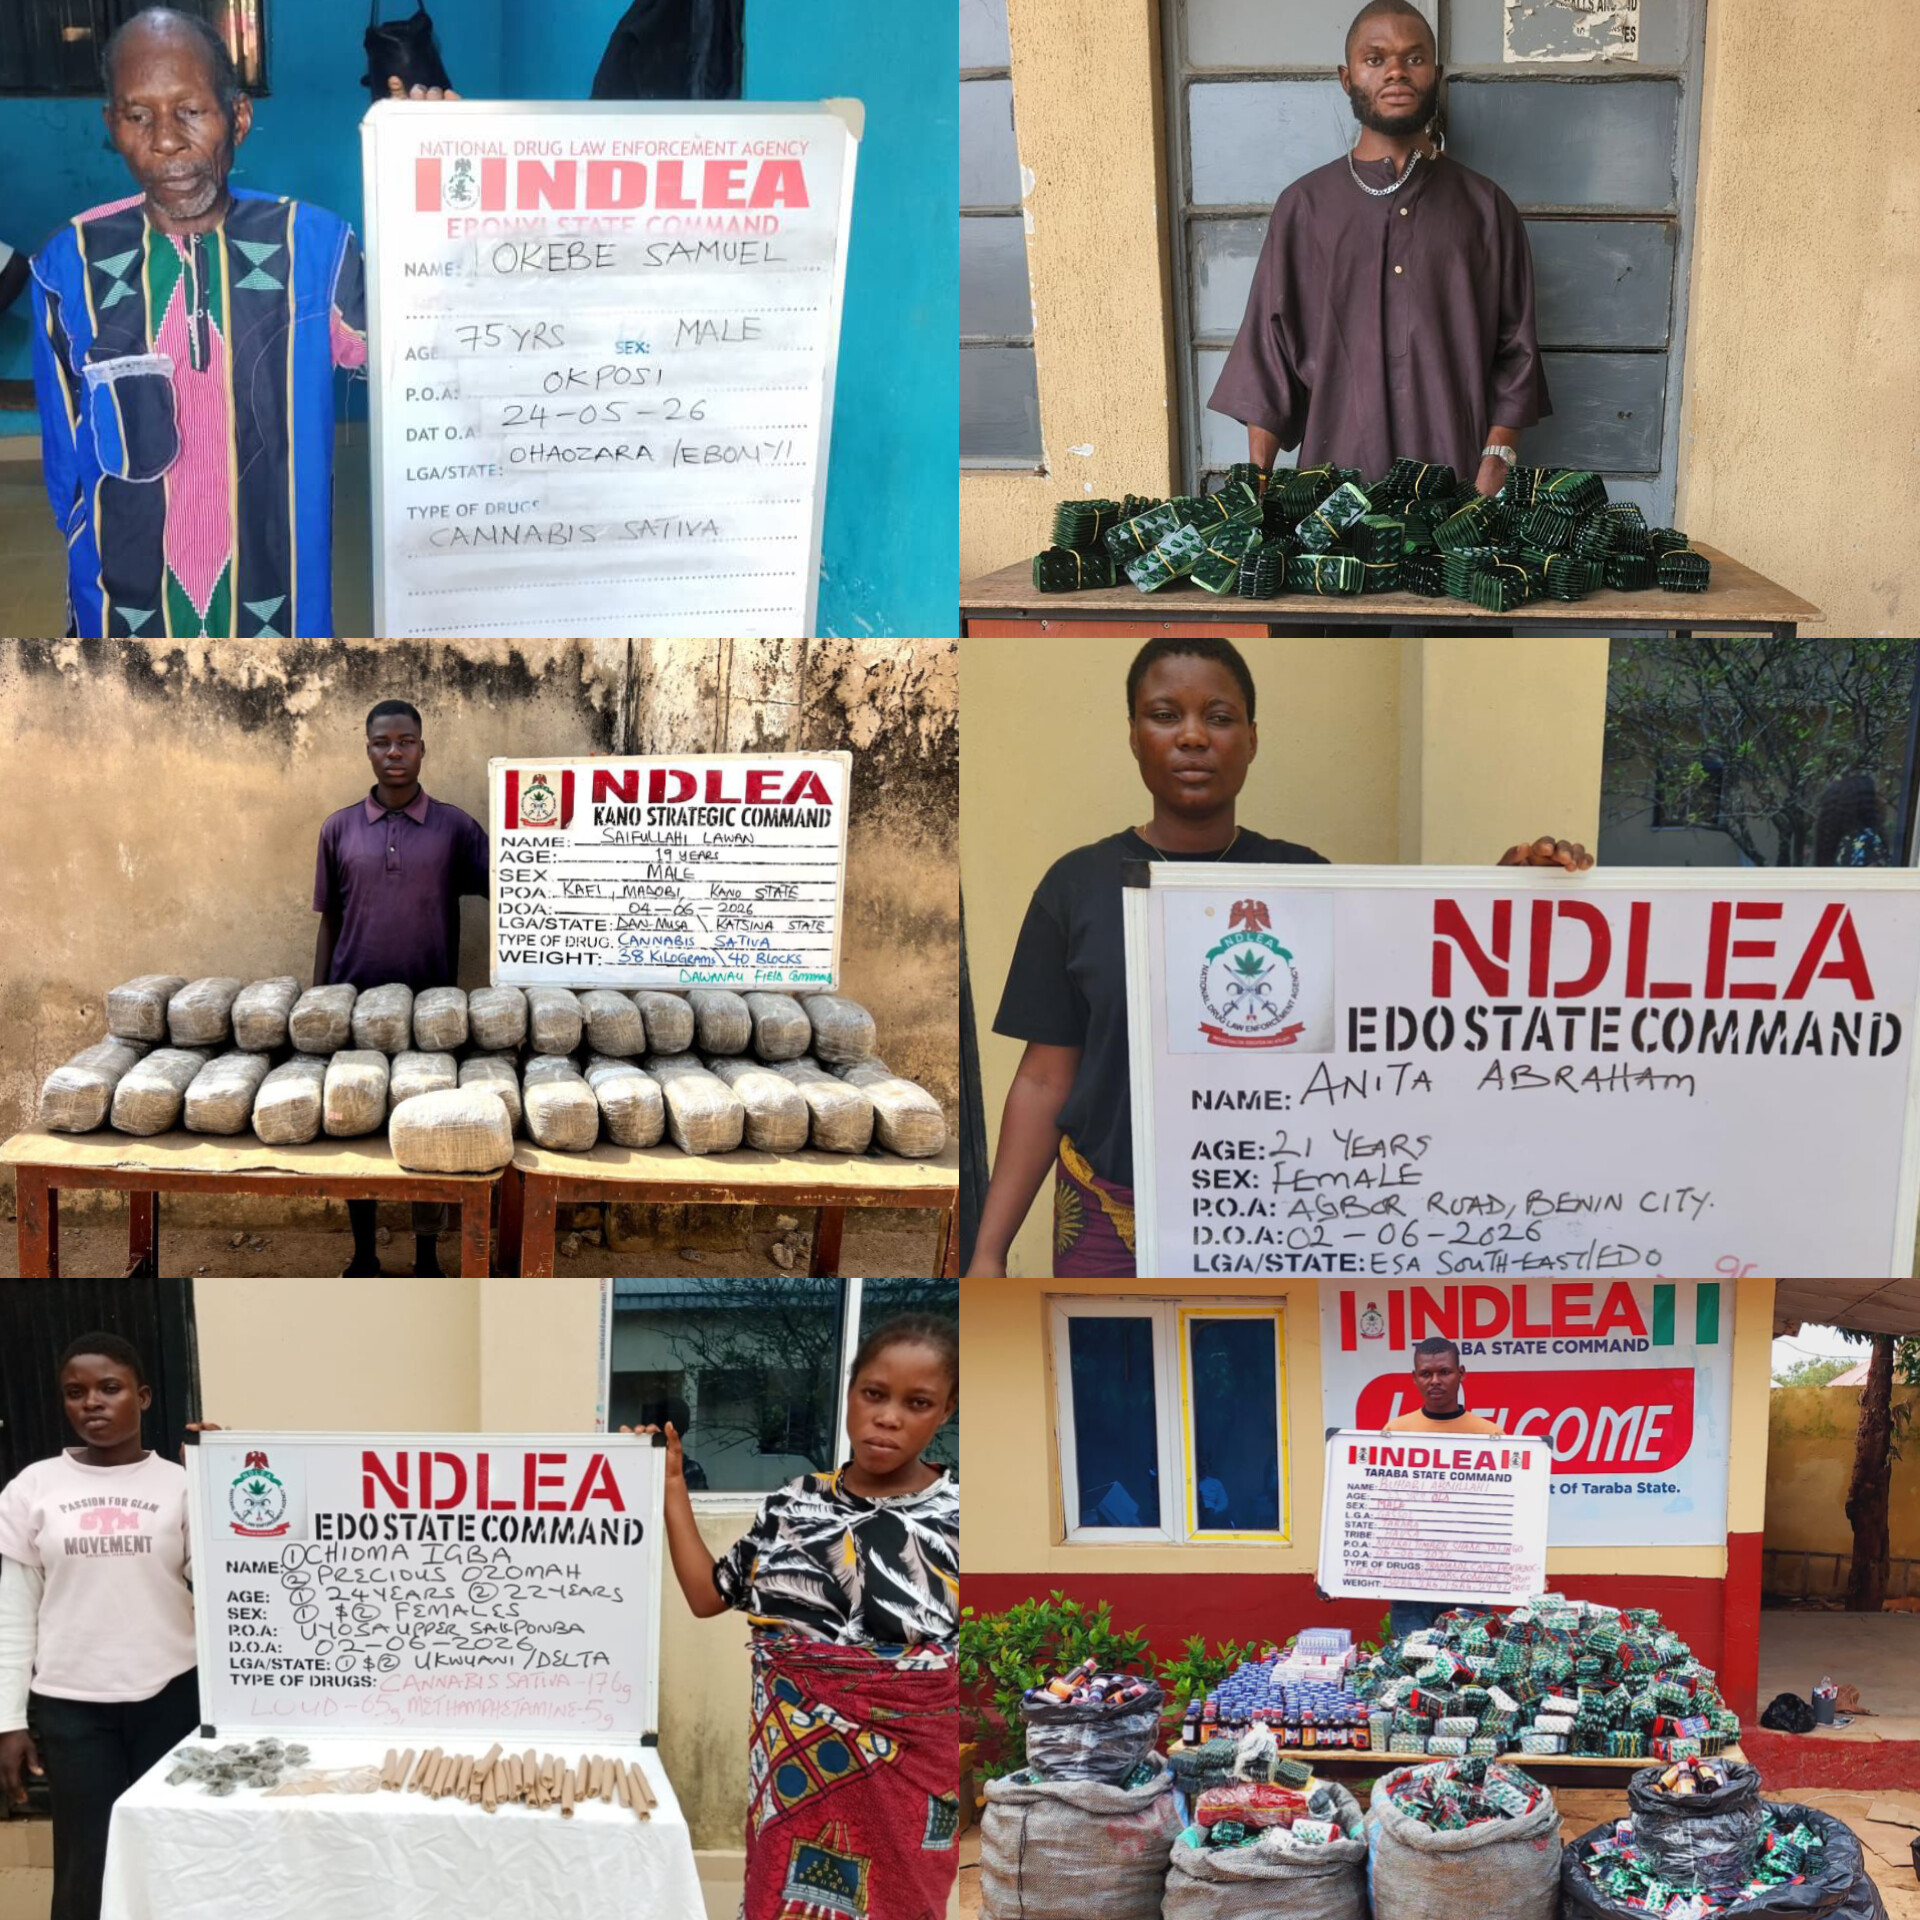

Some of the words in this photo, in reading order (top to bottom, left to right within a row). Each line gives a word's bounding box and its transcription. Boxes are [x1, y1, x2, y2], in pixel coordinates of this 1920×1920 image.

[420, 141, 508, 157] NATIONAL
[514, 141, 562, 156] DRUG
[570, 141, 606, 156] LAW
[612, 141, 738, 156] ENFORCEMENT
[741, 141, 810, 156] AGENCY
[646, 215, 779, 236] COMMAND
[493, 241, 616, 273] OKEBE
[643, 240, 787, 267] SAMUEL
[675, 317, 762, 347] MALE
[615, 340, 650, 354] SEX:
[406, 464, 503, 481] LGA/STATE:
[407, 505, 449, 520] TYPE
[456, 503, 479, 517] OF
[429, 522, 597, 547] CANNABIS
[618, 515, 719, 539] SATIVA
[592, 769, 833, 805] NDLEA
[594, 806, 641, 827] KANO
[647, 806, 736, 827] STRATEGIC
[741, 807, 831, 828] COMMAND
[501, 837, 571, 848] NAME:
[703, 831, 754, 844] LAWAN
[499, 850, 557, 864] AGE:
[656, 848, 672, 862] 19
[679, 850, 719, 861] YEARS
[647, 864, 695, 881] MALE
[711, 883, 742, 898] KANO
[755, 884, 799, 900] STATE
[498, 903, 552, 915] DOA:
[499, 917, 613, 931] LGA/STATE:
[717, 918, 774, 931] KATSINA
[788, 920, 825, 932] STATE
[499, 934, 536, 946] TYPE
[540, 935, 561, 947] OF
[618, 932, 695, 947] CANNABIS
[715, 935, 770, 948] SATIVA
[1223, 933, 1274, 948] NDLEA
[618, 948, 644, 963] 38
[756, 952, 802, 964] BLOCKS
[1431, 898, 1875, 1000] NDLEA
[498, 950, 602, 966] WEIGHT:
[1632, 1009, 1902, 1058] COMMAND
[1300, 1061, 1432, 1106] ANITA
[1191, 1090, 1291, 1111] NAME:
[1191, 1140, 1265, 1160] AGE:
[1269, 1130, 1311, 1158] 21
[1333, 1128, 1432, 1161] YEARS
[1191, 1169, 1259, 1190] SEX:
[1193, 1197, 1276, 1217] P.O.A:
[1526, 1189, 1622, 1217] BENIN
[1193, 1226, 1283, 1245] D.O.A:
[1193, 1253, 1365, 1273] LGA/STATE:
[1410, 1281, 1648, 1339] NDLEA
[1492, 1341, 1547, 1355] STATE
[1552, 1338, 1650, 1354] COMMAND
[1380, 1447, 1496, 1470] NDLEA
[362, 1451, 626, 1512] NDLEA
[1365, 1468, 1408, 1478] TARABA
[1412, 1471, 1446, 1479] STATE
[1450, 1472, 1512, 1482] COMMAND
[1563, 1482, 1581, 1494] Of
[1583, 1482, 1632, 1494] Taraba
[1637, 1481, 1680, 1494] State.
[59, 1497, 106, 1514] PASSION
[109, 1496, 128, 1507] FOR
[131, 1499, 160, 1513] GLAM
[482, 1515, 644, 1546] COMMAND
[64, 1535, 152, 1555] MOVEMENT
[306, 1542, 409, 1564] CHIOMA
[421, 1543, 511, 1565] IGBA
[226, 1561, 283, 1574] NAME:
[227, 1591, 270, 1603] AGE:
[227, 1607, 267, 1620] SEX:
[395, 1602, 519, 1620] FEMALES
[228, 1624, 277, 1637] P.O.A:
[397, 1622, 460, 1637] UPPER
[229, 1641, 282, 1653] D.O.A:
[230, 1657, 331, 1671] LGA/STATE:
[230, 1674, 274, 1686] TYPE
[280, 1674, 304, 1687] OF
[310, 1674, 377, 1688] DRUGS:
[379, 1672, 498, 1692] CANNABIS
[506, 1671, 570, 1690] SATIVA
